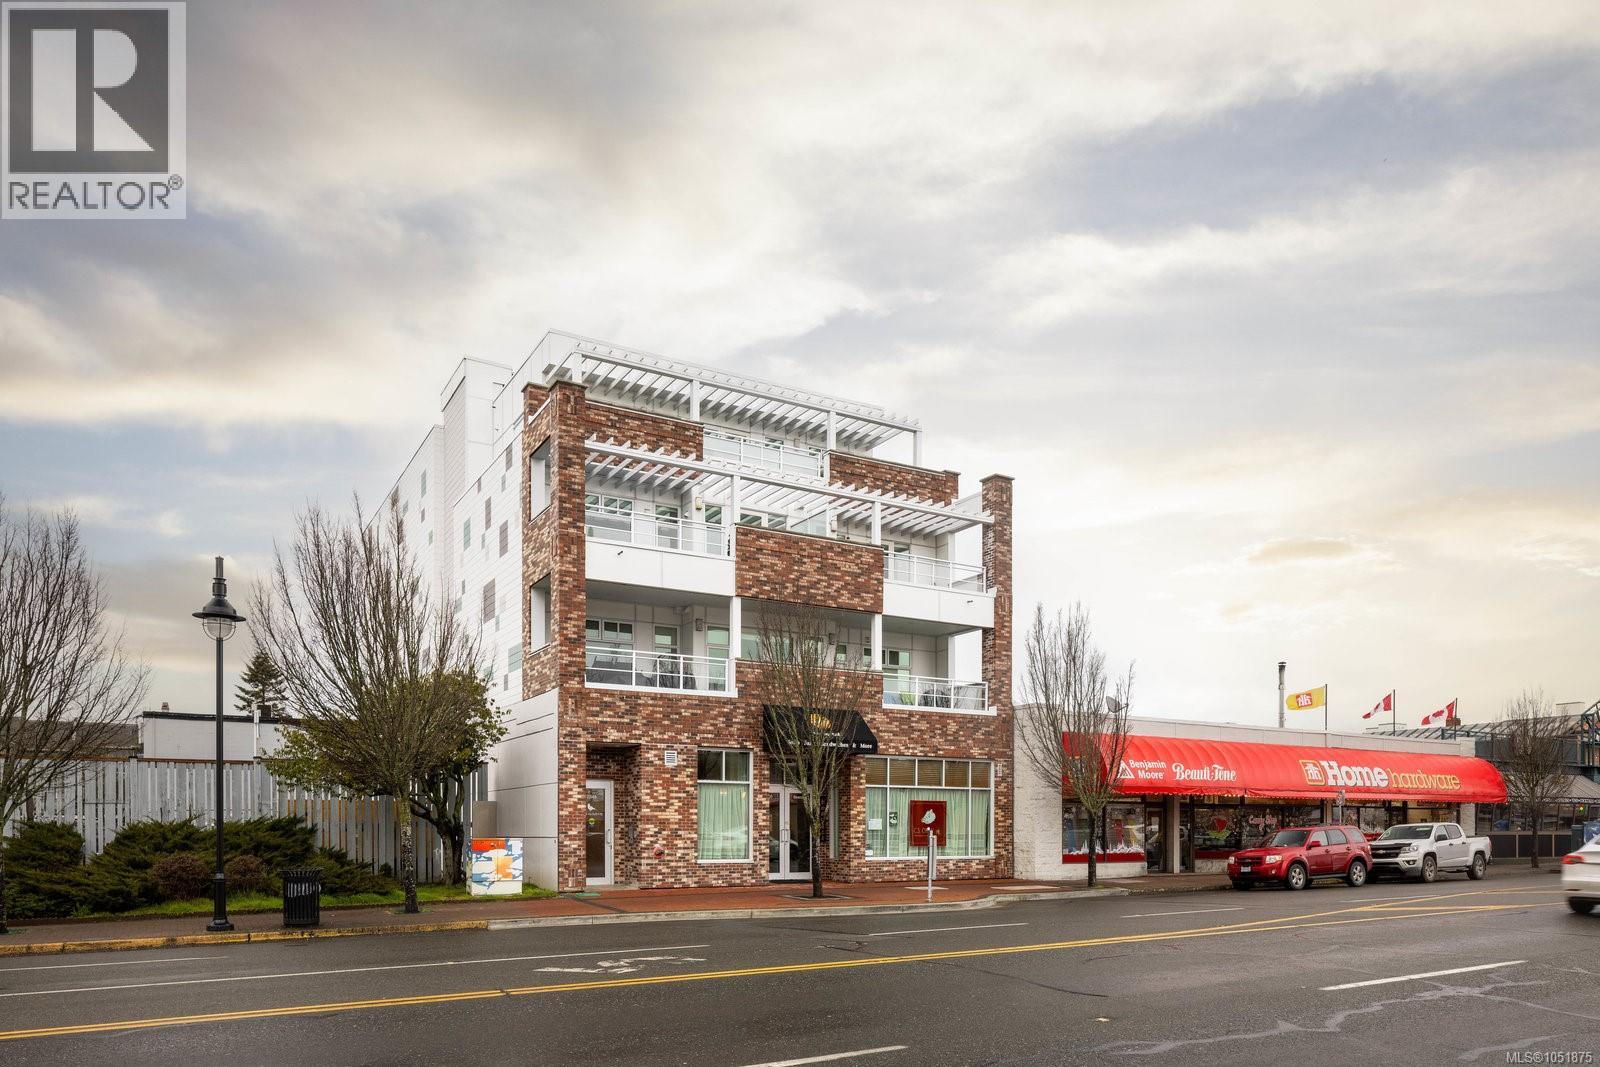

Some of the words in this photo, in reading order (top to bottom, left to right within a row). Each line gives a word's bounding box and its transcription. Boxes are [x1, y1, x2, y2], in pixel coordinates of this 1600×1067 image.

[1128, 759, 1167, 770] Benjamin
[1171, 762, 1237, 782] Beauti-Tone
[1138, 770, 1164, 779] Moore
[1320, 760, 1389, 787] Home
[1388, 768, 1461, 790] hardware
